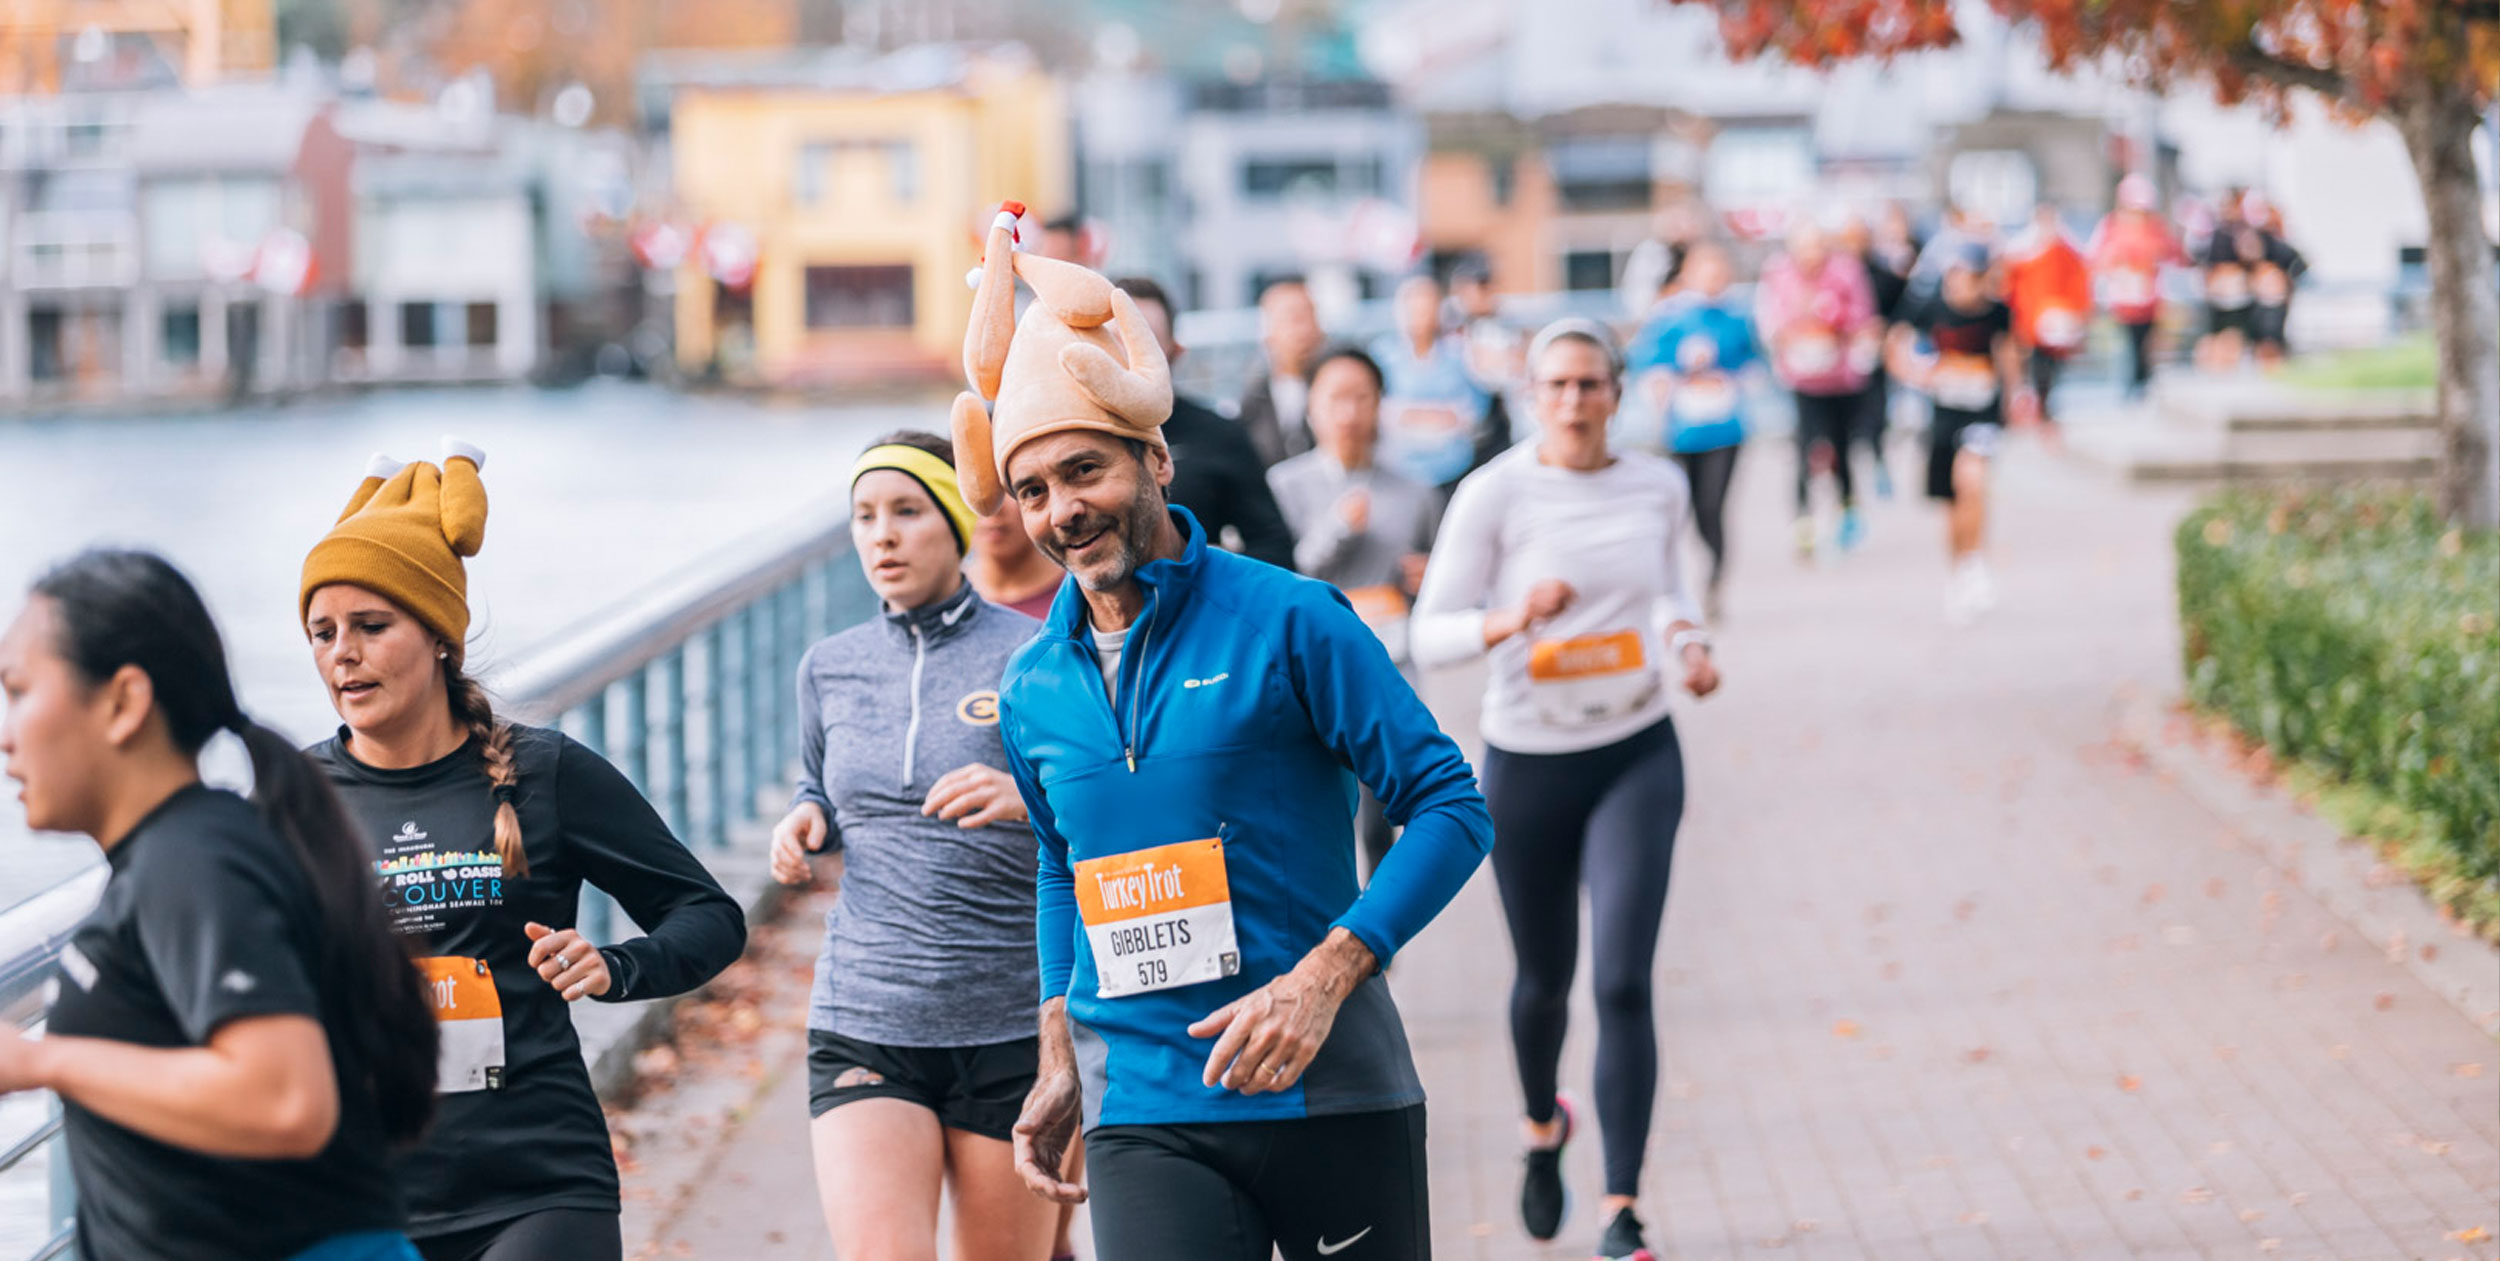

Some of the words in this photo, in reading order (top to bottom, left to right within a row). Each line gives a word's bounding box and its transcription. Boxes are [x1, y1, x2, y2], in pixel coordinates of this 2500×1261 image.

[396, 869, 435, 887] ROLL
[459, 865, 502, 880] OASIS
[1110, 918, 1192, 957] GIBBLETS
[1137, 958, 1168, 986] 579
